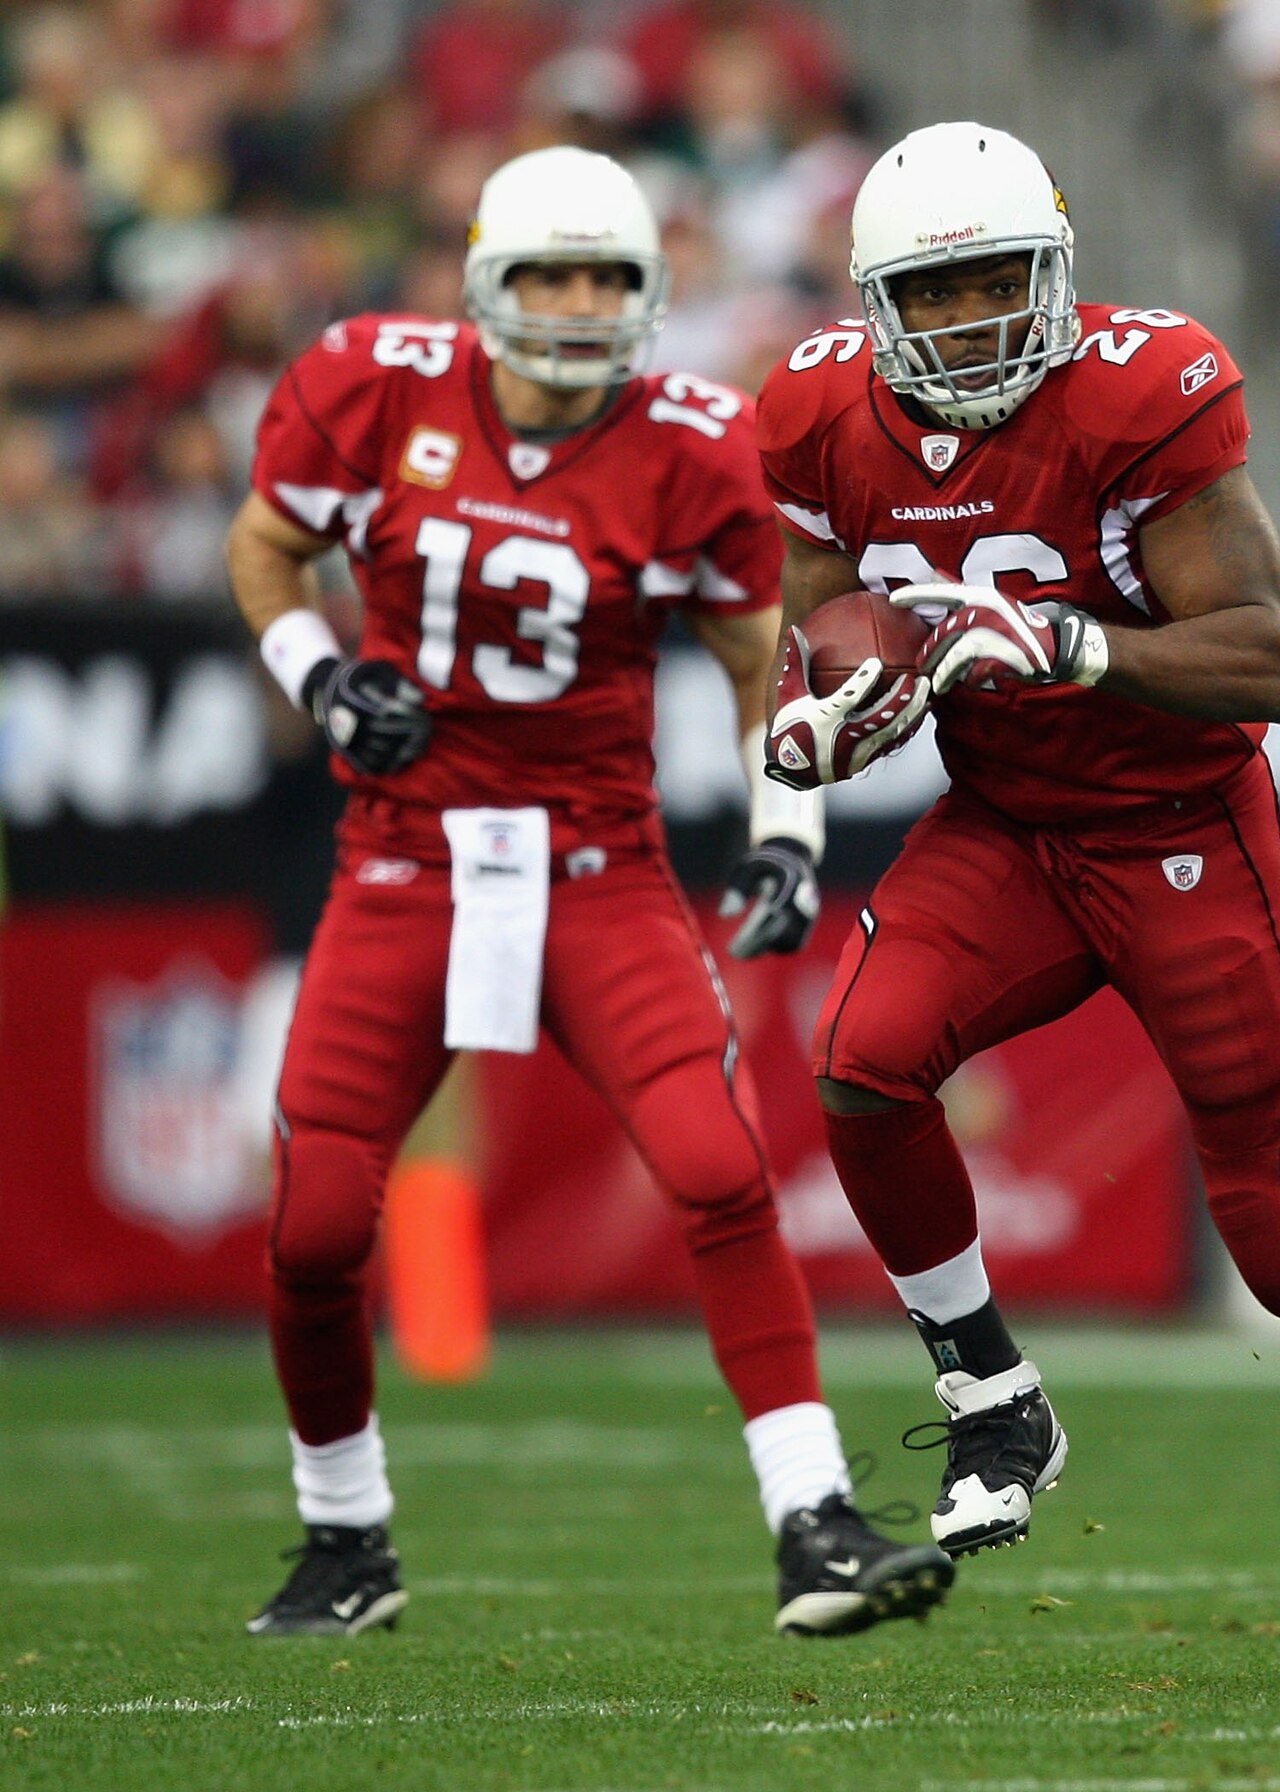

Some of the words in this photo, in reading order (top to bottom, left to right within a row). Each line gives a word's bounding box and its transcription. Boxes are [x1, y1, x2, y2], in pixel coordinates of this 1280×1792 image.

[930, 225, 974, 246] Riddell
[372, 321, 459, 378] 13
[648, 373, 742, 440] 13
[407, 431, 459, 477] C
[891, 500, 994, 521] CARDINALS
[415, 516, 591, 703] 13
